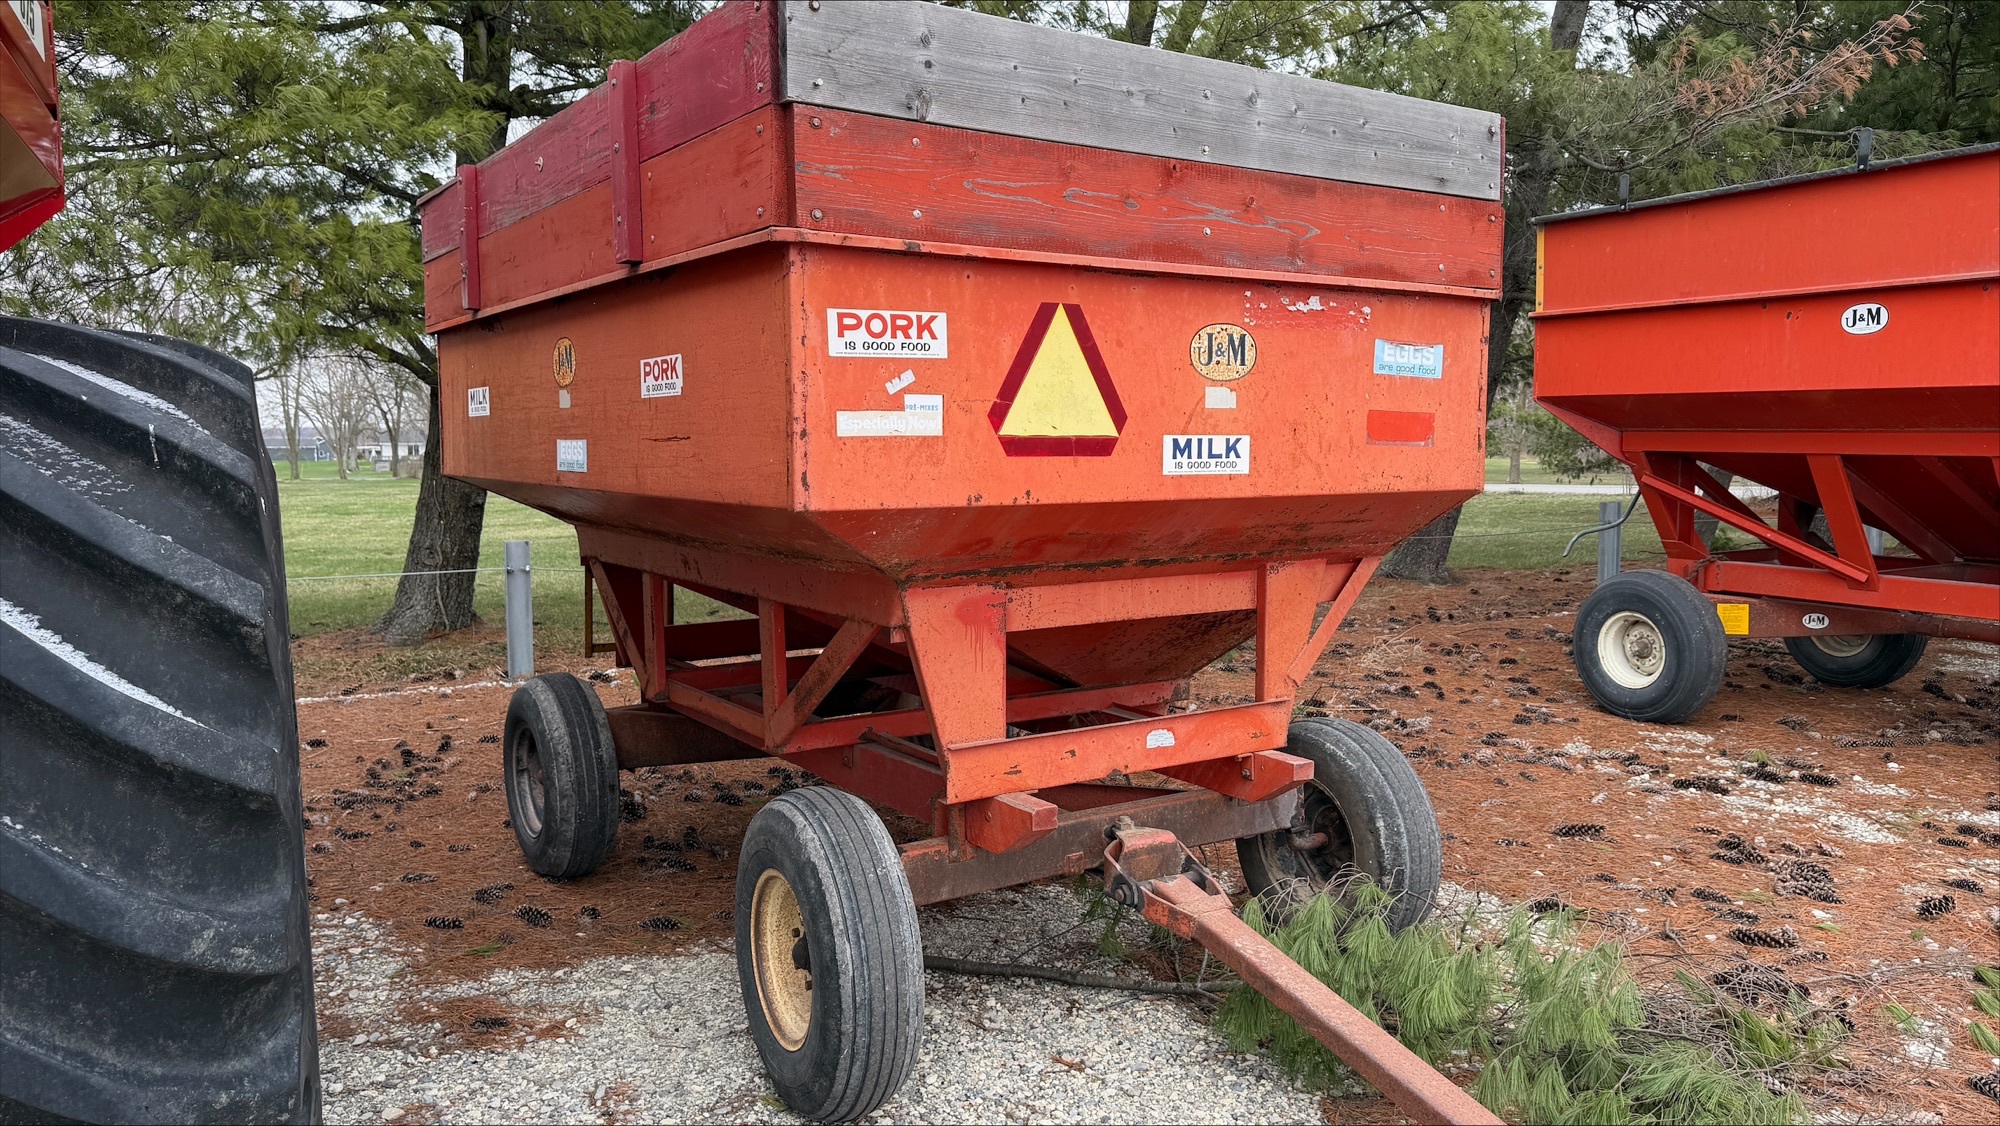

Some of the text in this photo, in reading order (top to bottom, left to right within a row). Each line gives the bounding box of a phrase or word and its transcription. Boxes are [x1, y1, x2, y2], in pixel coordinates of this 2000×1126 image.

[836, 312, 939, 341] PORK
[1845, 306, 1882, 328] J&M
[844, 340, 931, 352] IS GOOD FOOD
[1197, 332, 1248, 367] J&M
[1383, 341, 1435, 366] EGGS
[643, 356, 680, 383] PORK
[1379, 363, 1437, 376] are good food
[645, 384, 651, 393] IS
[664, 381, 676, 391] FOOD
[470, 388, 488, 406] MILK
[839, 414, 906, 433] Especially
[560, 441, 584, 460] EGGS
[1172, 437, 1243, 460] MILK
[1174, 460, 1238, 470] IS GOOD FOOD
[1804, 615, 1825, 626] J&M
